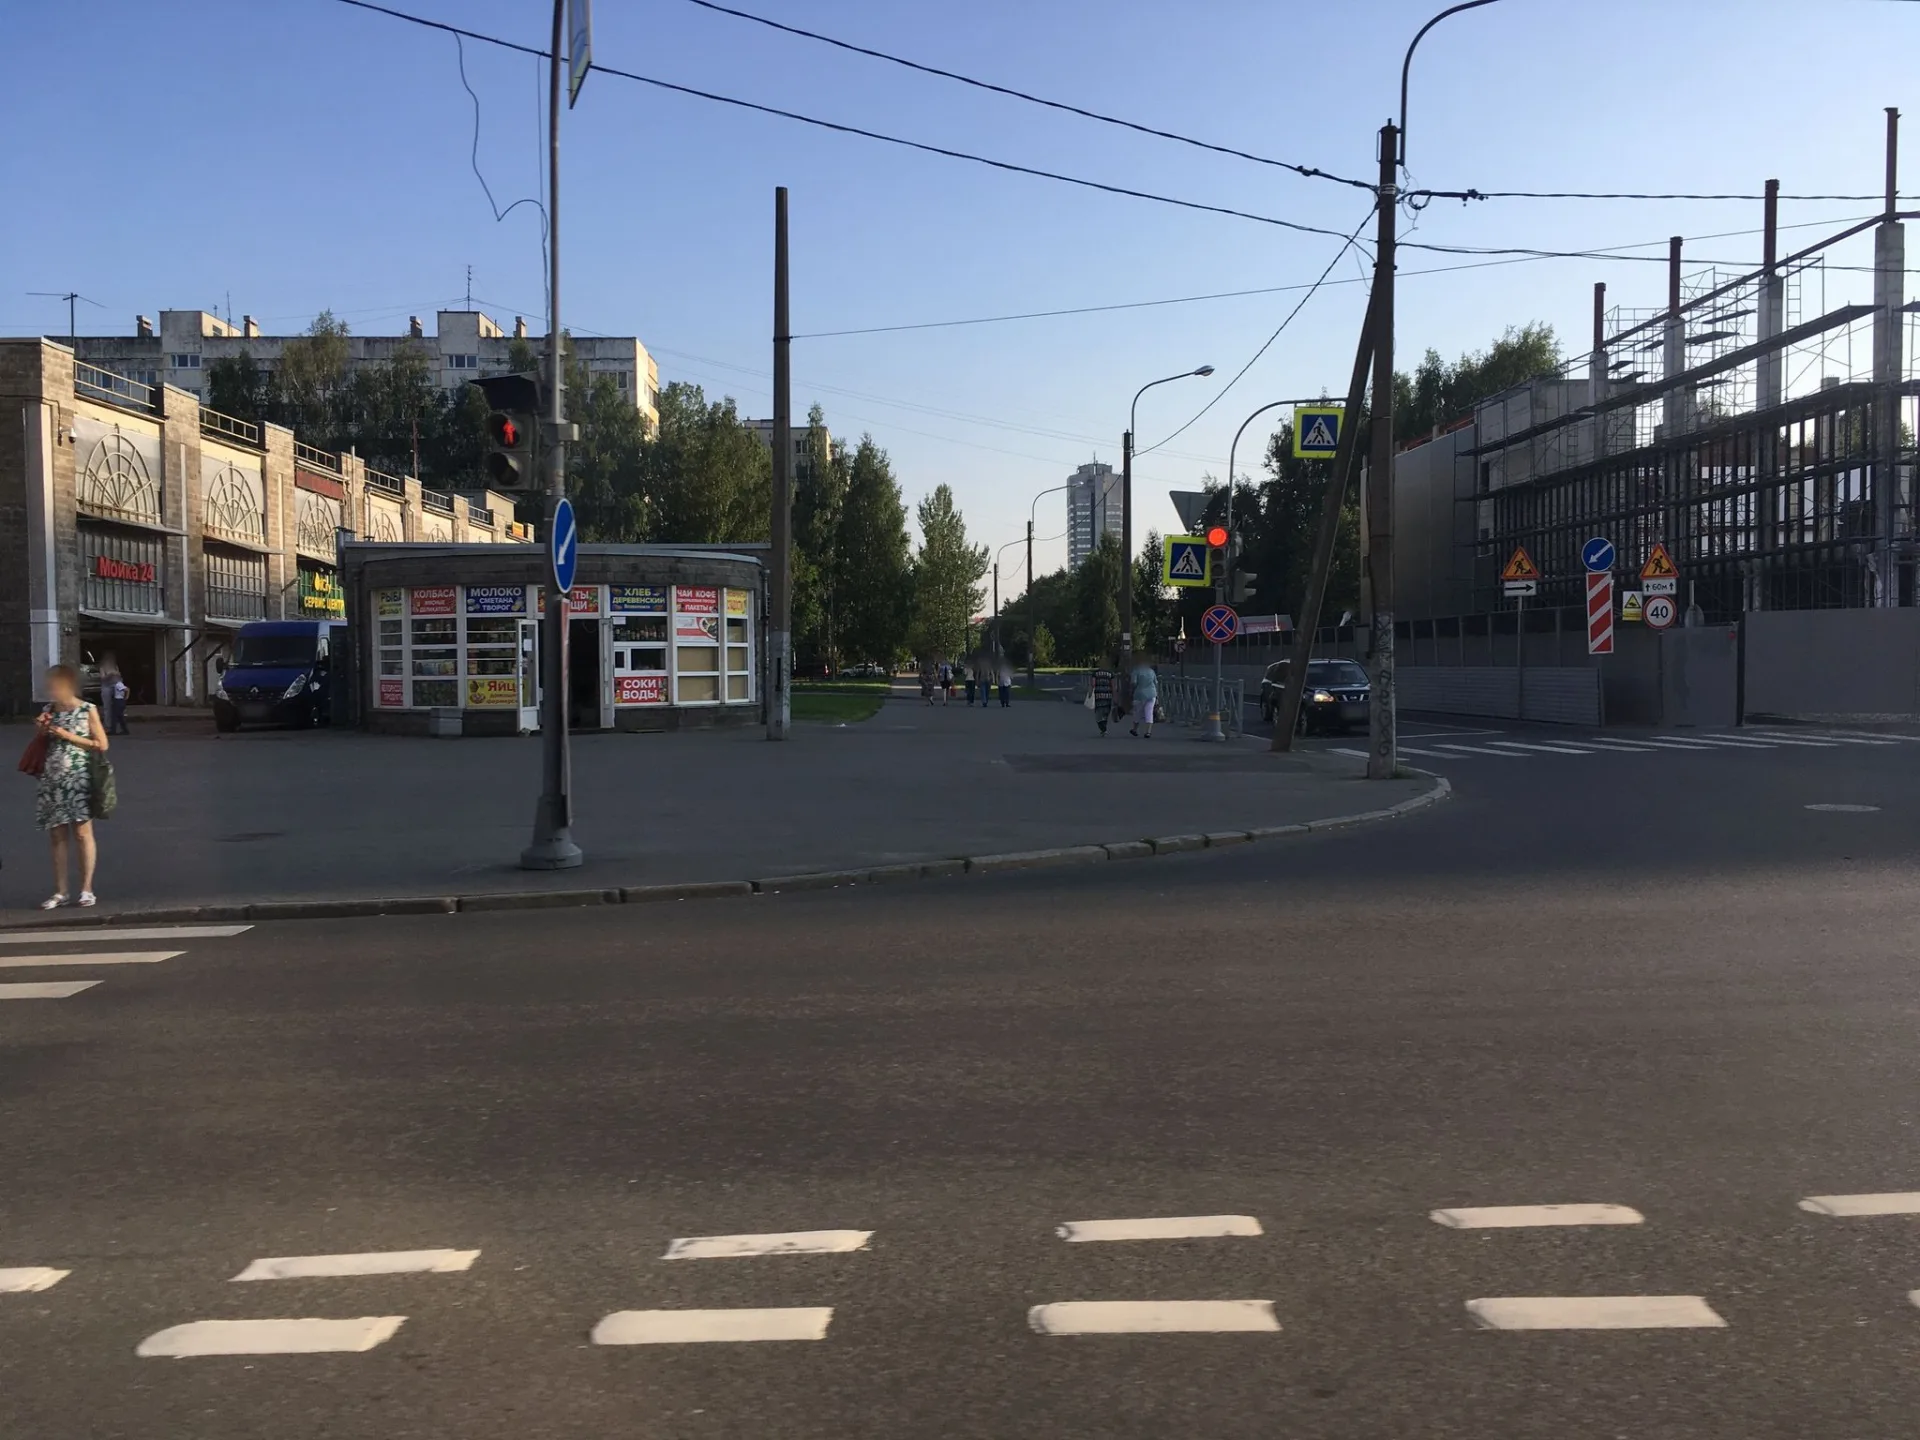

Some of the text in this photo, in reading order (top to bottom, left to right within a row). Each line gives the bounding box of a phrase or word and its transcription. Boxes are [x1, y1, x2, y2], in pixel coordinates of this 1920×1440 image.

[97, 555, 155, 582] Мойка 24
[471, 587, 522, 597] МОЛОКО
[624, 587, 651, 596] ХЛЕБ
[1652, 583, 1668, 591] 60м
[413, 589, 455, 599] КОЛБАСА
[677, 588, 716, 598] ЧАЙ КОФЕ
[1650, 605, 1669, 619] 40
[487, 679, 518, 693] Яйц
[623, 679, 657, 689] СОКИ
[622, 690, 658, 700] ВОДЫ
